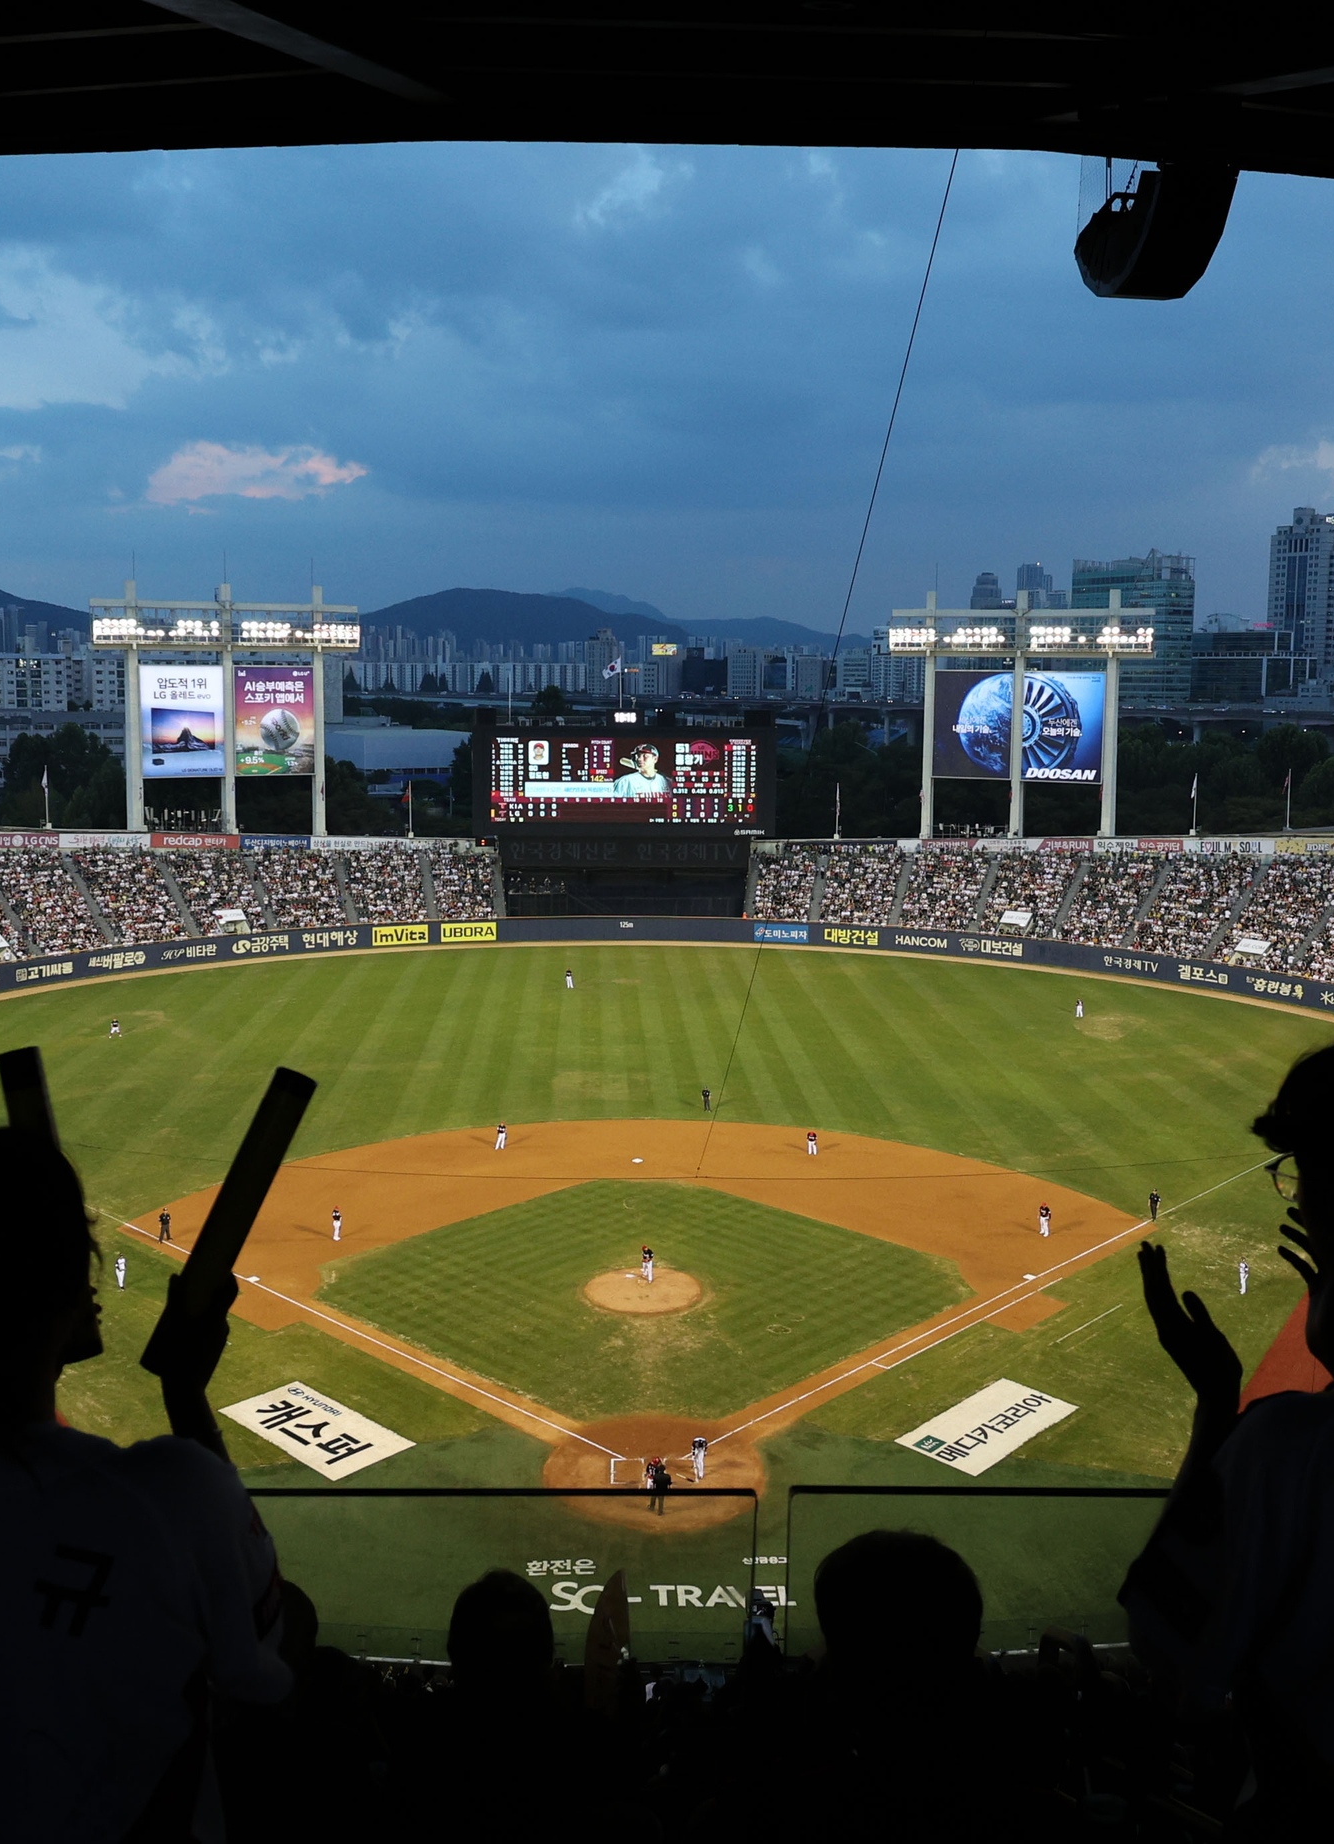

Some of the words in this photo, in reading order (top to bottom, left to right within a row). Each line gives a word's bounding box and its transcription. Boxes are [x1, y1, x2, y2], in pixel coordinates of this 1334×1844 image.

[157, 678, 188, 690] 압도적
[191, 678, 207, 690] 1위
[153, 691, 167, 700] LG
[170, 691, 196, 700] 올레드
[244, 693, 274, 704] 스포키
[1042, 727, 1065, 737] 오늘의
[1025, 767, 1097, 781] DOOSAN
[727, 803, 734, 812] 3
[747, 803, 754, 812] 0
[25, 836, 37, 845] LG
[39, 836, 58, 845] CNS
[163, 835, 203, 847] redcap
[1046, 840, 1089, 850] 기부&RUN
[442, 926, 495, 938] UBORA
[619, 921, 634, 929] 125m
[302, 930, 359, 948] 현대해상
[764, 929, 808, 940] 도미노피자
[824, 928, 879, 946] 대방건설
[251, 934, 289, 953] 금강주택
[895, 935, 947, 949] HANCOM
[980, 939, 1023, 957] 대보건설
[186, 944, 218, 958] 비타란
[1103, 955, 1159, 973] 한국경제TV
[1178, 964, 1218, 983] 겔포스
[302, 1394, 343, 1417] HYUNDAI
[255, 1399, 374, 1466] 캐스퍼
[935, 1393, 1052, 1462] 메디카코리아
[525, 1558, 597, 1577] 환전은
